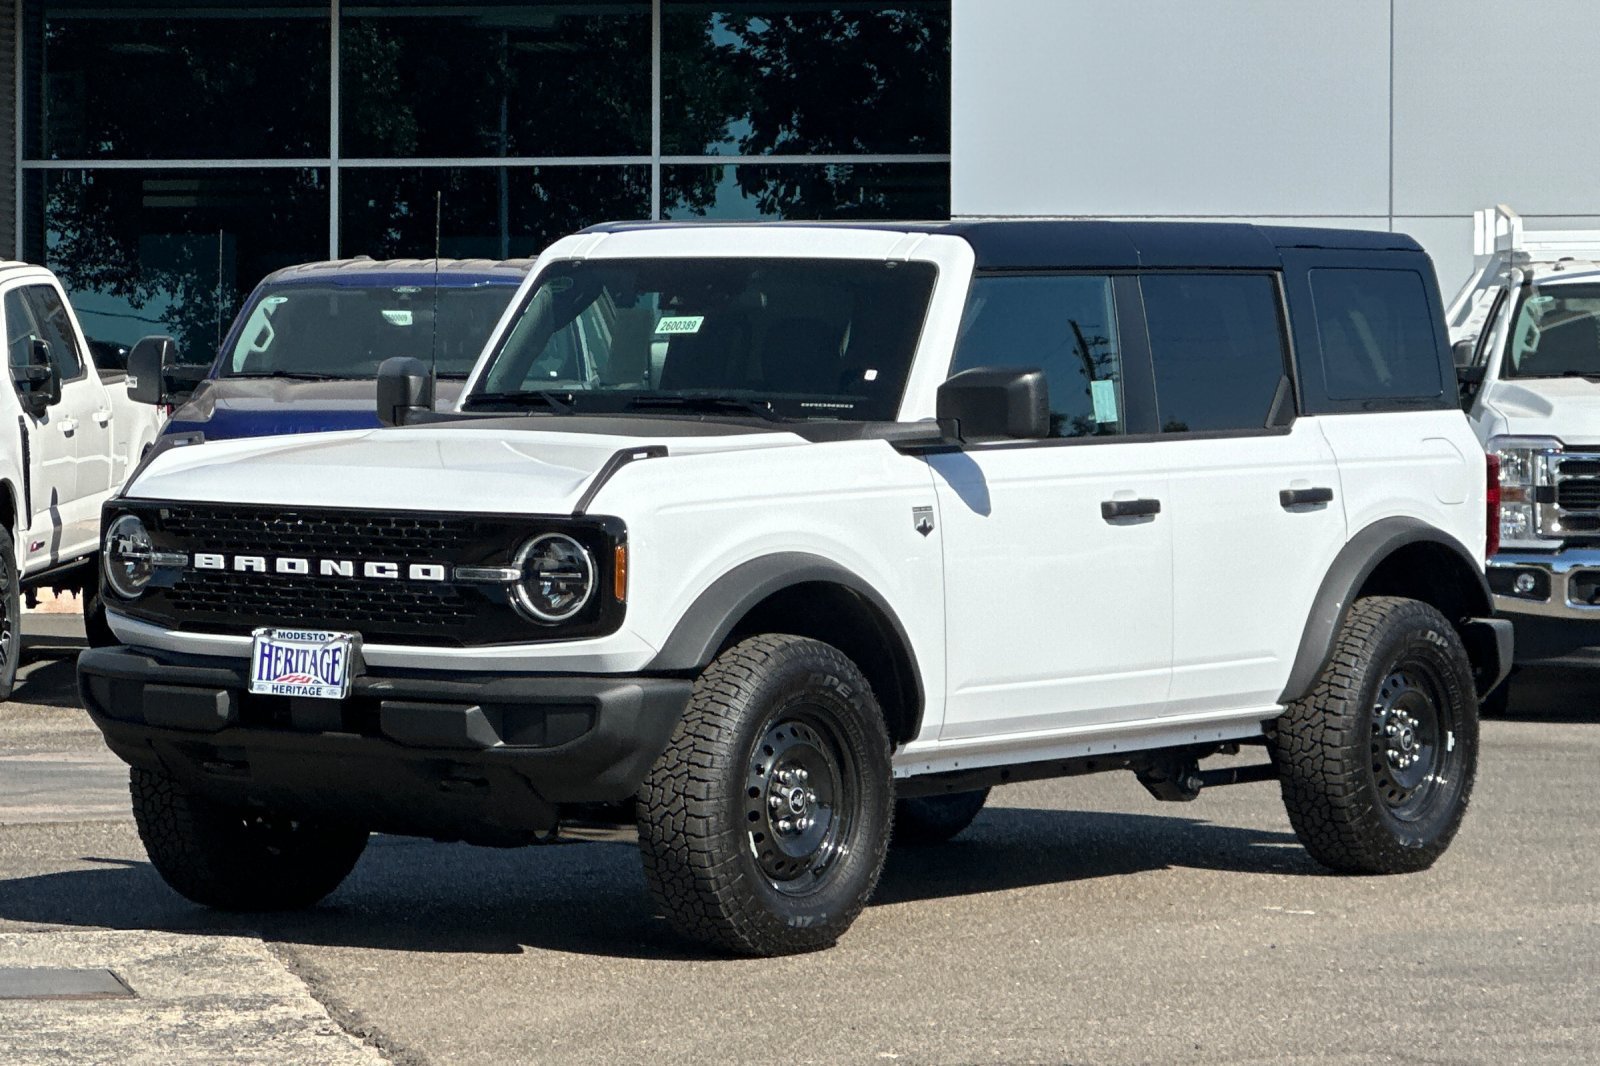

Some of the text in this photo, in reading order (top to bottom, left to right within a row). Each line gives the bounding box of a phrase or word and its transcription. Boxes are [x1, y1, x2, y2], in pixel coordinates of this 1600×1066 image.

[660, 320, 698, 331] 2600389
[194, 553, 445, 581] BRONCO
[277, 631, 326, 641] MODESTO
[257, 641, 342, 686] HERITAGE
[271, 684, 323, 696] HERITAGE
